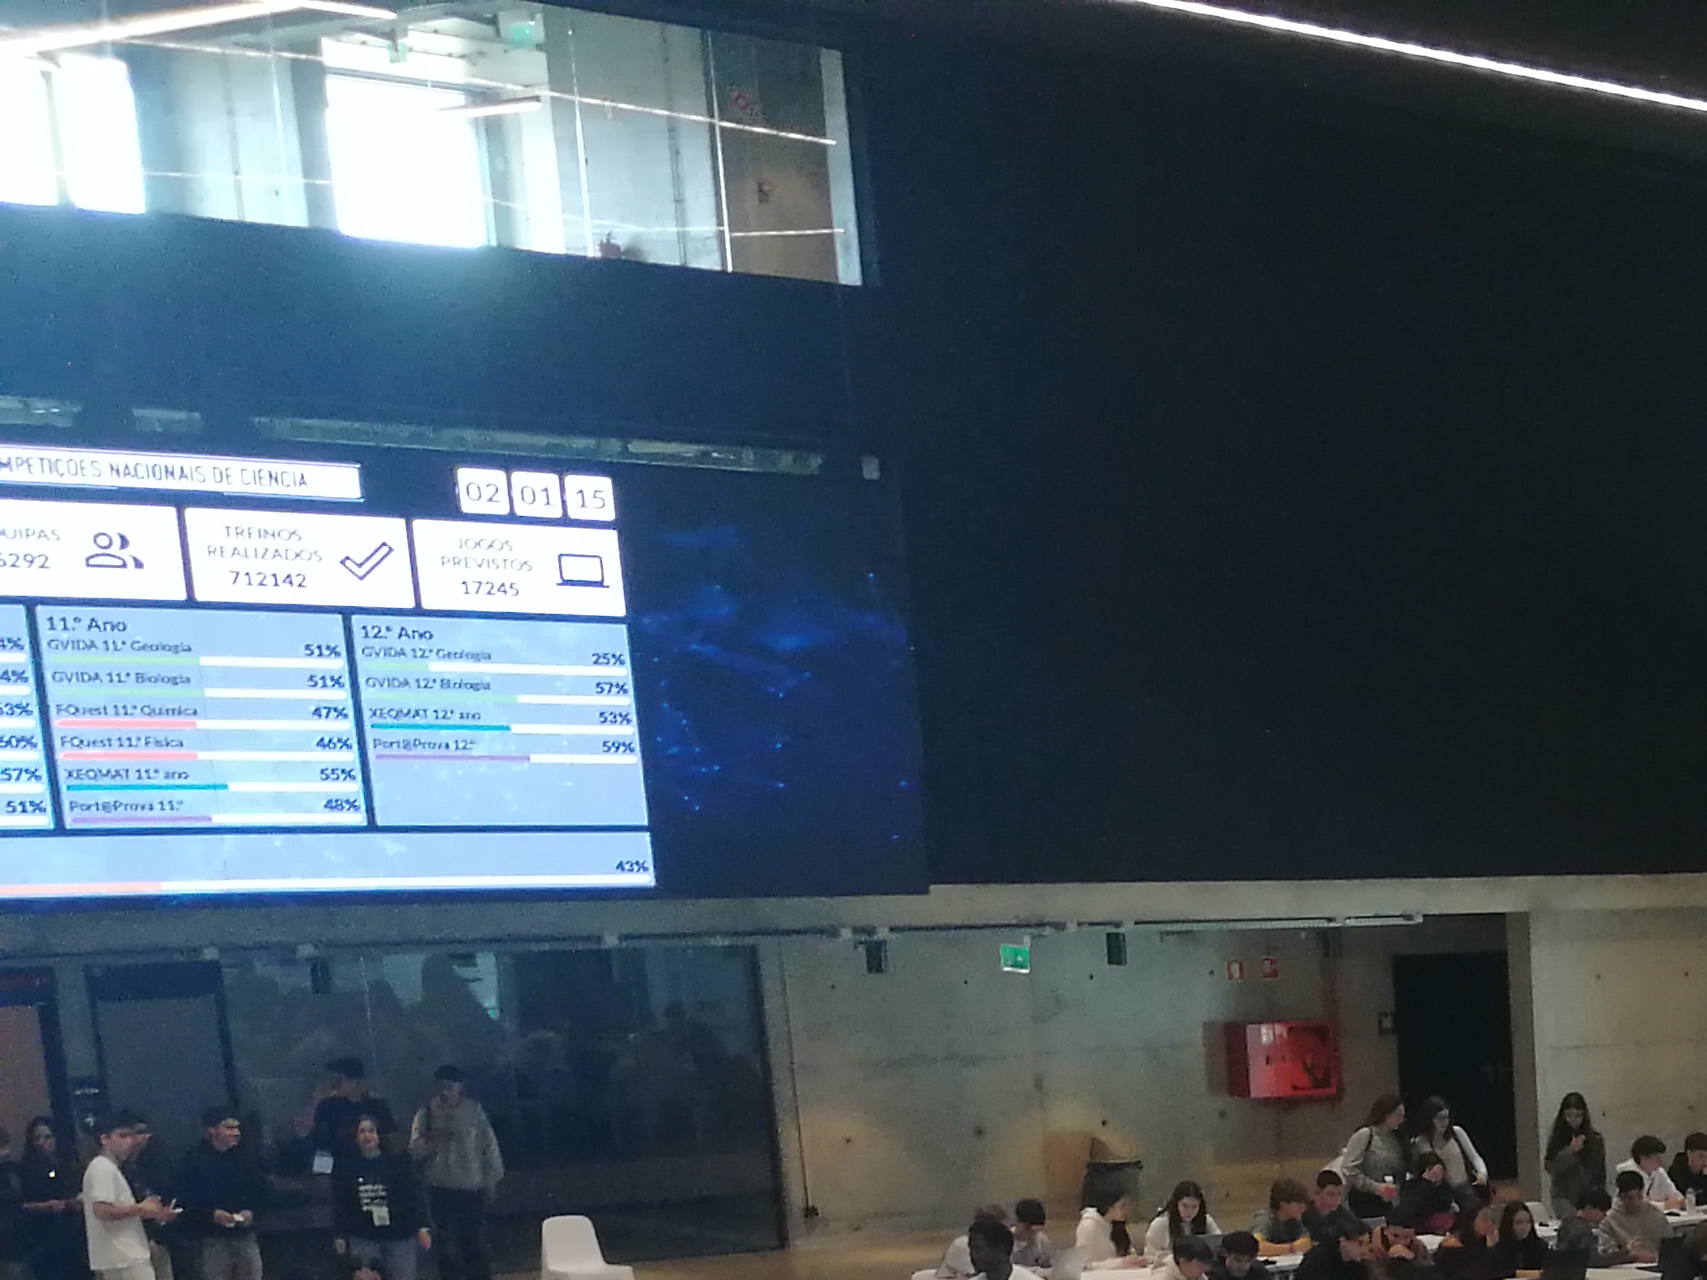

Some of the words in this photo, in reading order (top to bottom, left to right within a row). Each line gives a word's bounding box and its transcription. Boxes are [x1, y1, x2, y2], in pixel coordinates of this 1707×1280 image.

[109, 461, 206, 484] NACIONAIS
[212, 465, 233, 485] DE
[465, 481, 501, 504] 02
[520, 485, 555, 507] 01
[575, 489, 606, 510] 15
[0, 527, 61, 542] UIPAS
[223, 525, 303, 542] TREINOS
[457, 537, 514, 552] JOGOS
[206, 544, 323, 563] REALIZADOS
[440, 555, 533, 572] PREVISTOS
[228, 570, 309, 589] 712142
[460, 580, 520, 597] 17245
[87, 617, 128, 633] Ano
[397, 626, 434, 641] Ano
[303, 643, 342, 658] 51%
[591, 652, 626, 666] 25%
[306, 673, 346, 689] 51%
[594, 681, 630, 695] 57%
[310, 705, 350, 720] 47%
[598, 711, 633, 725] 53%
[601, 740, 637, 754] 59%
[319, 767, 358, 782] 55%
[6, 800, 47, 814] 51%
